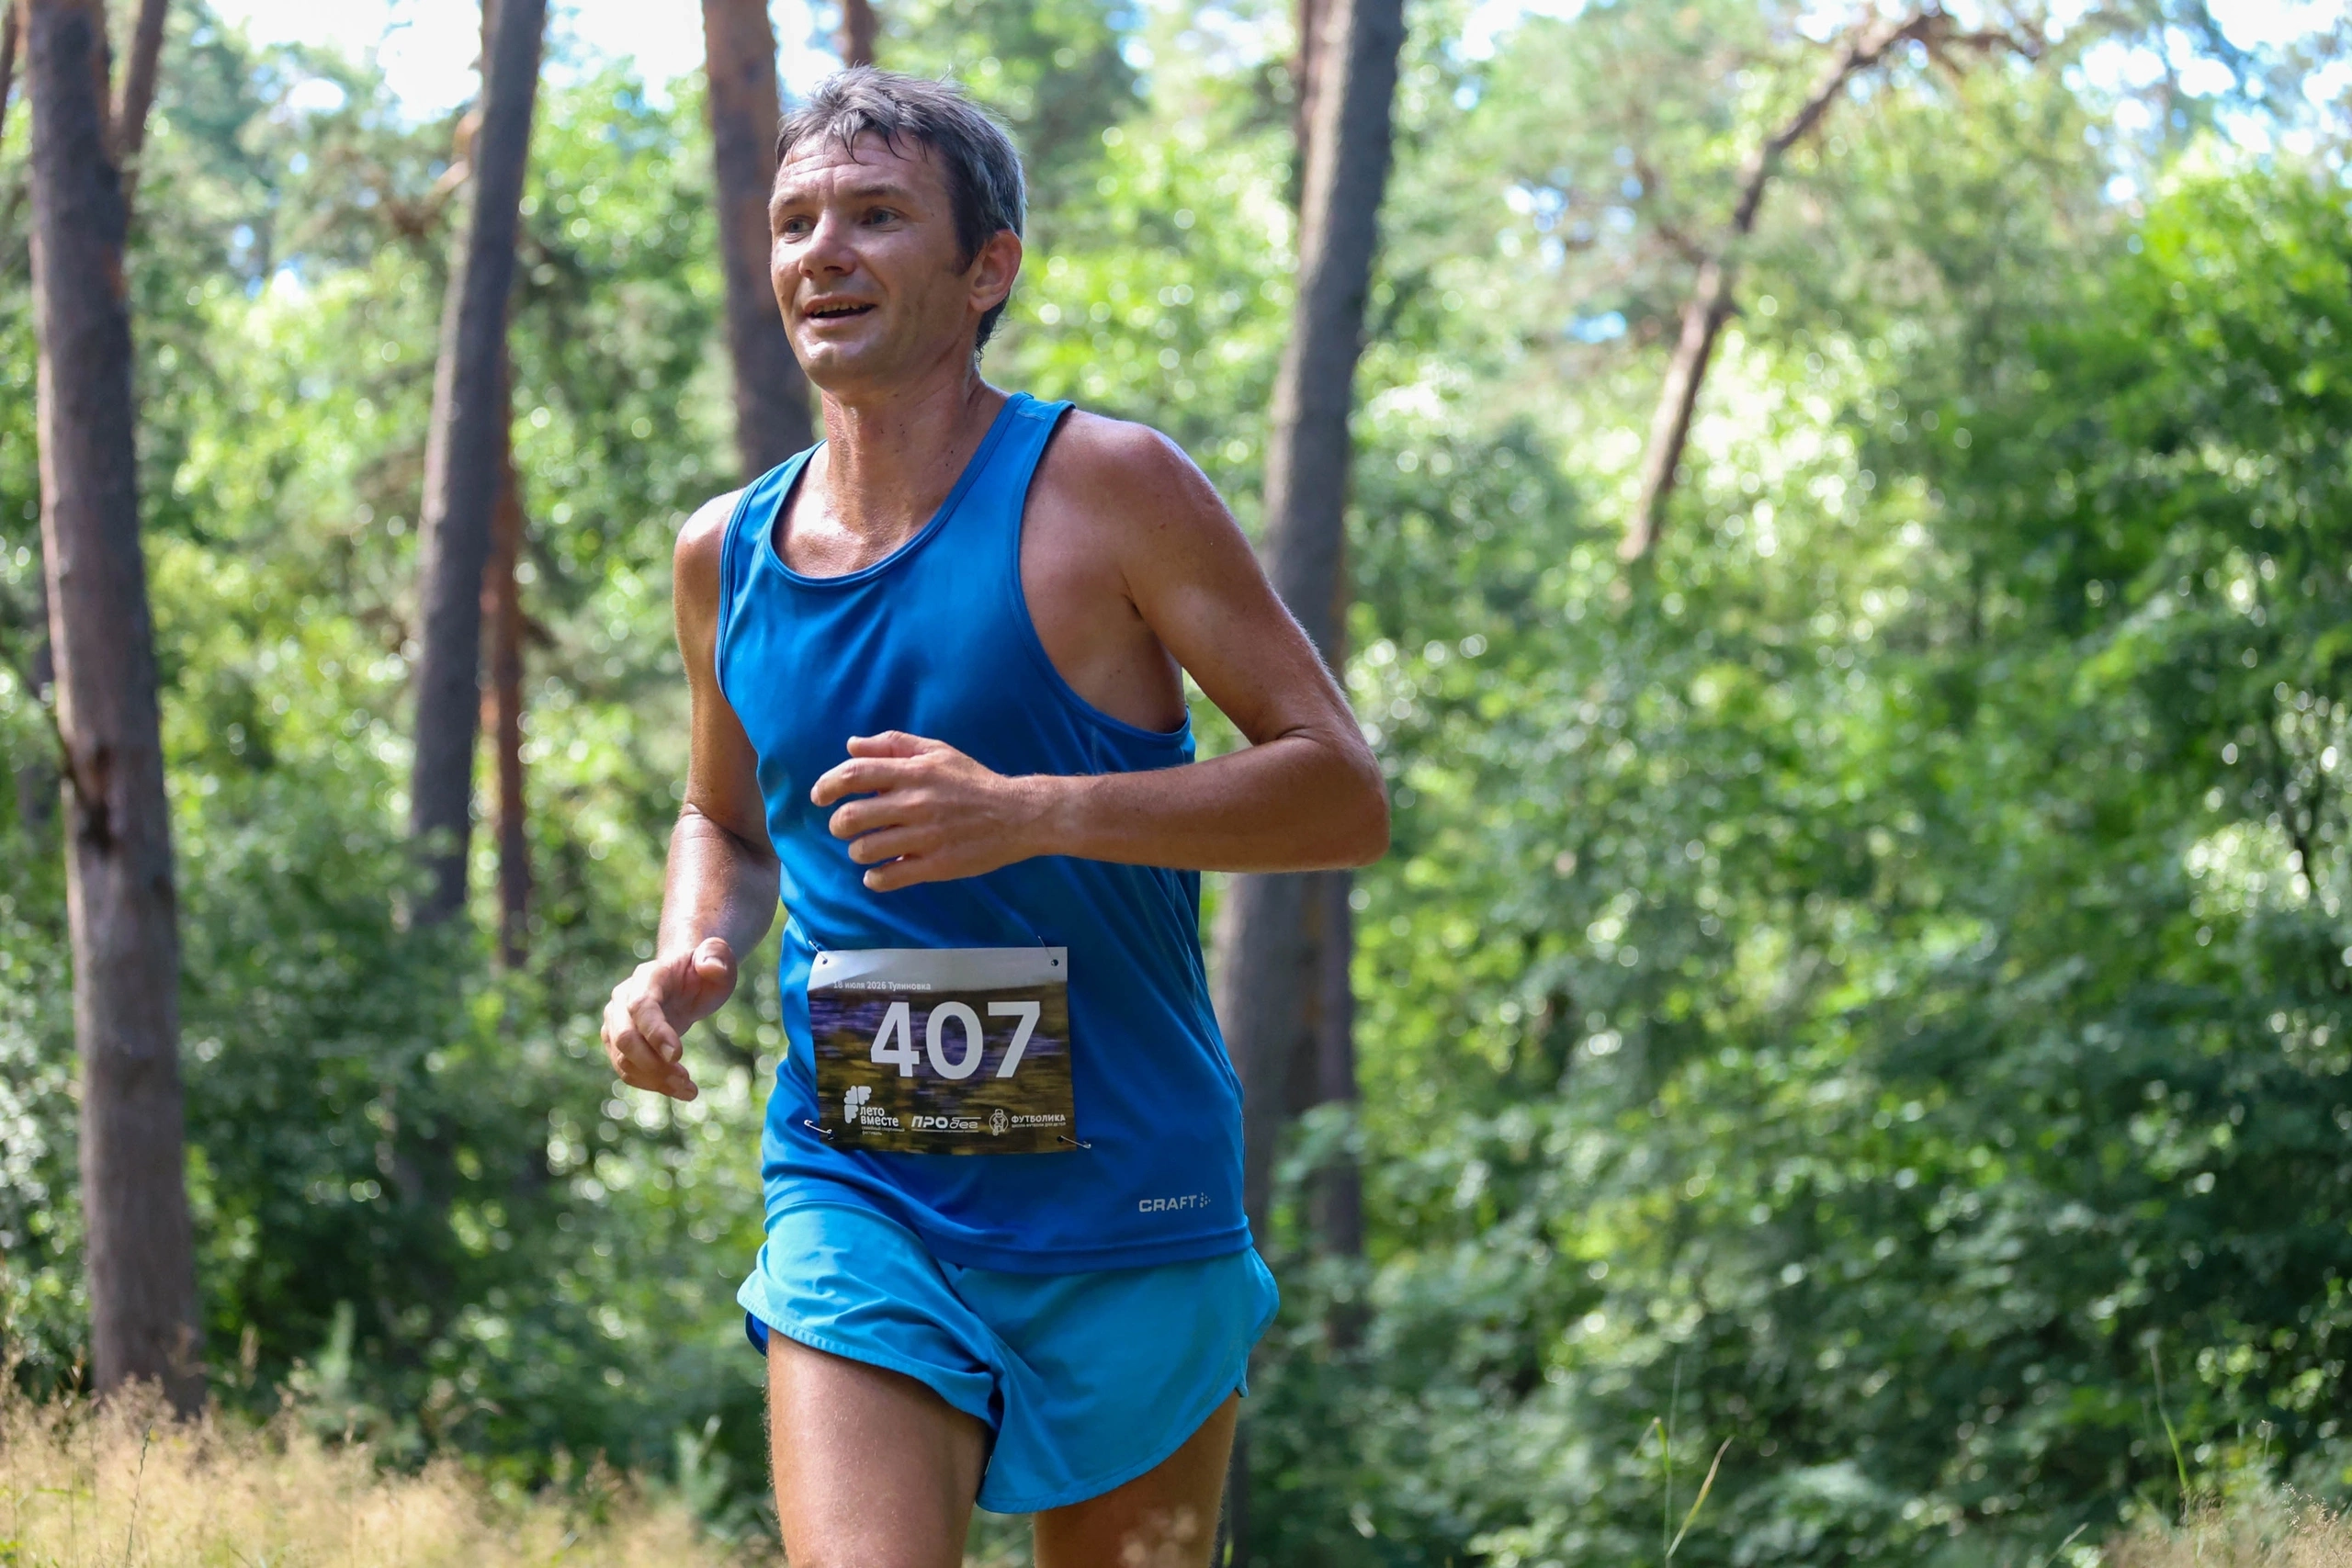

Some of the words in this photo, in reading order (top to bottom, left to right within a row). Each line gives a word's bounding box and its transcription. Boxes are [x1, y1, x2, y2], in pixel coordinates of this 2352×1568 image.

[845, 981, 865, 989] июля
[866, 981, 887, 990] 2026
[888, 981, 932, 992] Тулиновка
[870, 1001, 1041, 1080] 407
[1011, 1113, 1066, 1123] ФУТБОЛИКА
[1138, 1194, 1198, 1213] CRAFT
